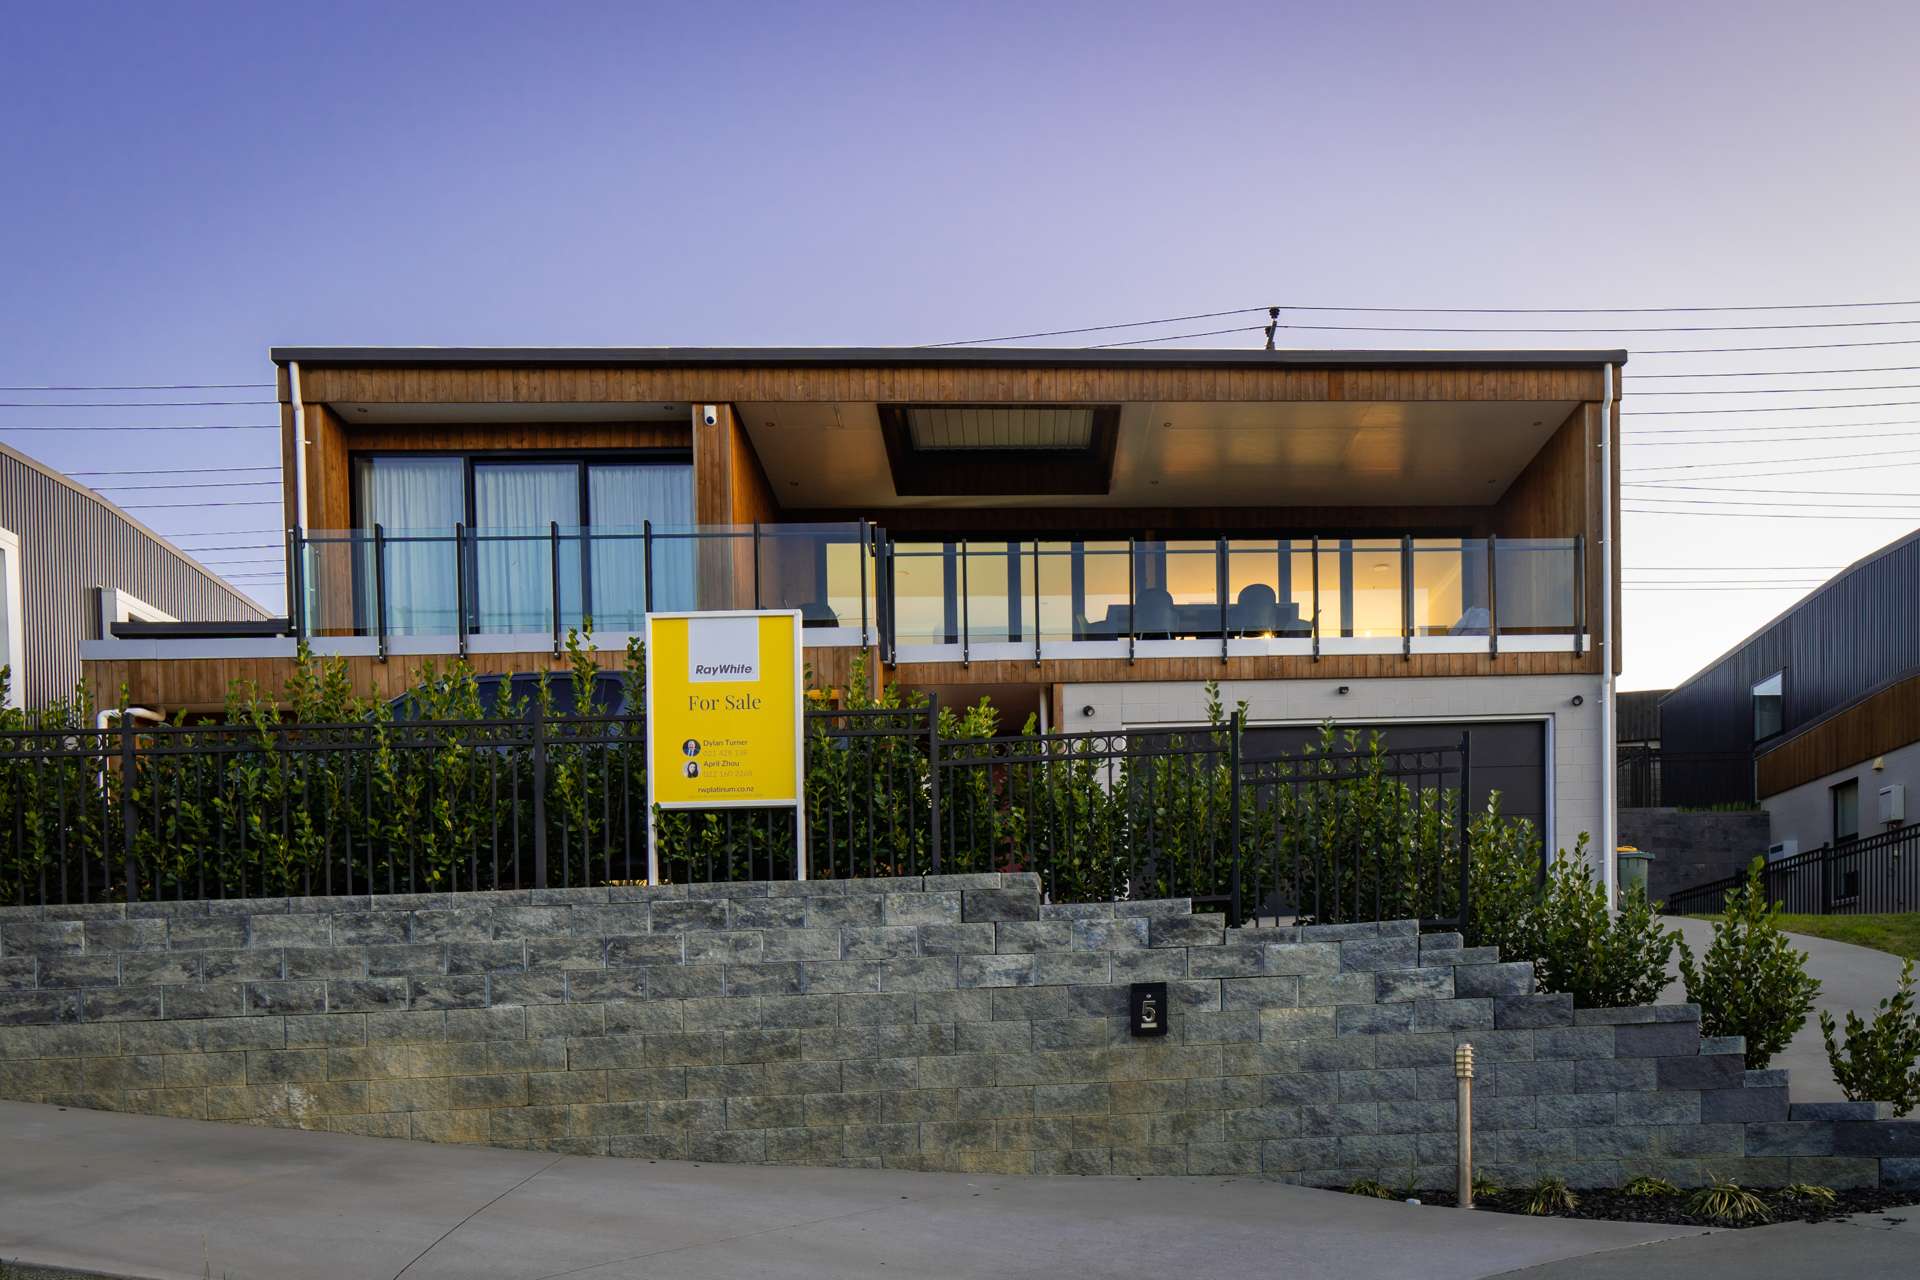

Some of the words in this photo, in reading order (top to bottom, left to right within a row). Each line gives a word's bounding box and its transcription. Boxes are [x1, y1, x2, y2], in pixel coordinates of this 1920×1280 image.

[688, 695, 720, 711] For
[725, 693, 762, 710] Sale
[703, 739, 724, 747] Dylan
[703, 760, 720, 768] April
[1141, 1000, 1156, 1022] 5
